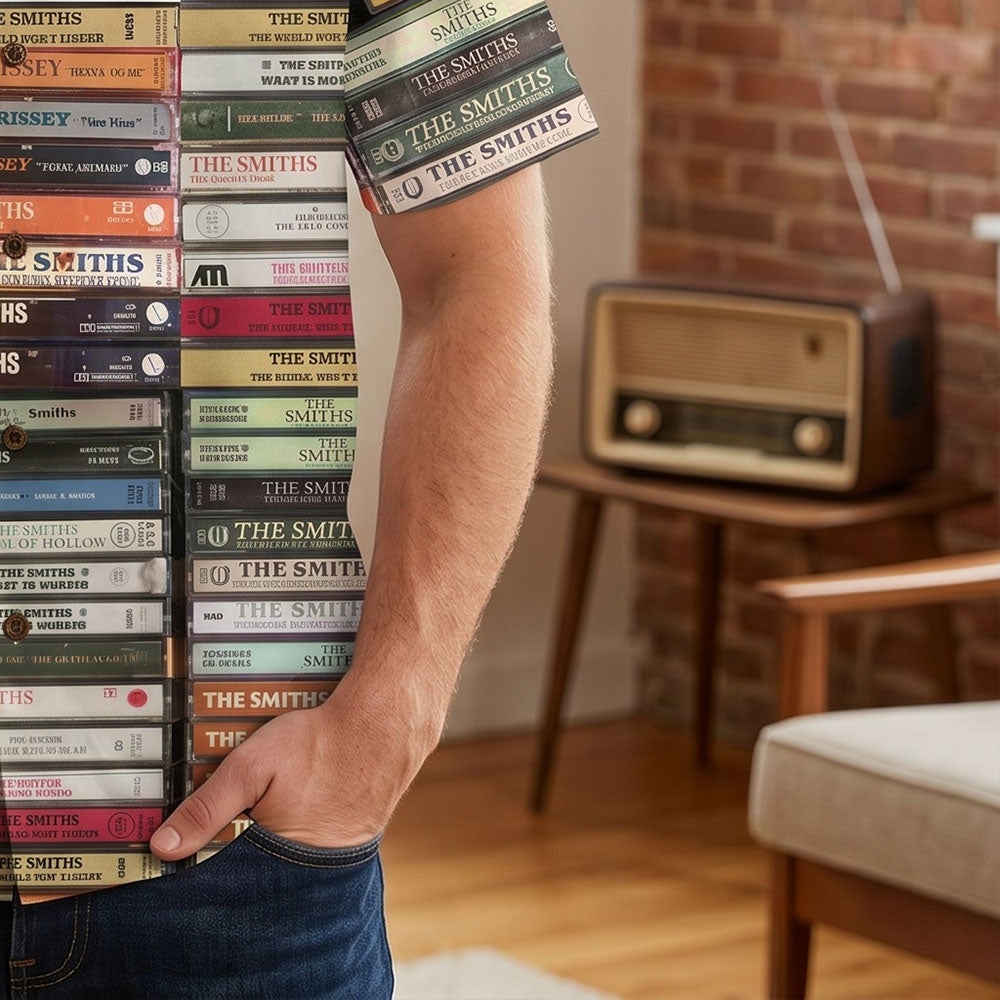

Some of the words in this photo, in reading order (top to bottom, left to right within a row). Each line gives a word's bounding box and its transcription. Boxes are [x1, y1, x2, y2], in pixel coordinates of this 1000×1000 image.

[442, 0, 473, 20] THE
[9, 12, 82, 25] SMITHS
[269, 13, 302, 25] THE
[430, 1, 498, 43] SMITHS
[249, 33, 272, 42] THE
[411, 64, 450, 91] THE
[450, 33, 519, 73] SMITHS
[302, 75, 315, 86] IS
[405, 110, 455, 147] THE
[460, 66, 552, 122] SMITHS
[426, 151, 477, 183] THE
[481, 107, 572, 161] SMITHS
[190, 156, 233, 173] THE
[236, 155, 318, 172] SMITHS
[275, 223, 295, 231] THE
[33, 251, 145, 272] SMITHS
[269, 303, 303, 316] THE
[269, 353, 304, 365] THE
[250, 373, 273, 382] THE
[304, 399, 335, 409] THE
[28, 407, 77, 419] Smiths
[285, 409, 353, 423] SMITHS
[318, 438, 347, 448] THE
[261, 481, 300, 495] THE
[22, 524, 79, 536] SMITHS
[234, 522, 285, 540] THE
[19, 539, 39, 549] OF
[43, 537, 107, 549] HOLLOW
[26, 568, 75, 578] SMITHS
[239, 561, 287, 578] THE
[236, 602, 282, 618] THE
[321, 645, 346, 654] THE
[203, 692, 245, 709] THE
[250, 691, 328, 709] SMITHS
[205, 731, 247, 748] THE
[25, 815, 79, 826] SMITHS
[25, 857, 83, 869] SMITHS
